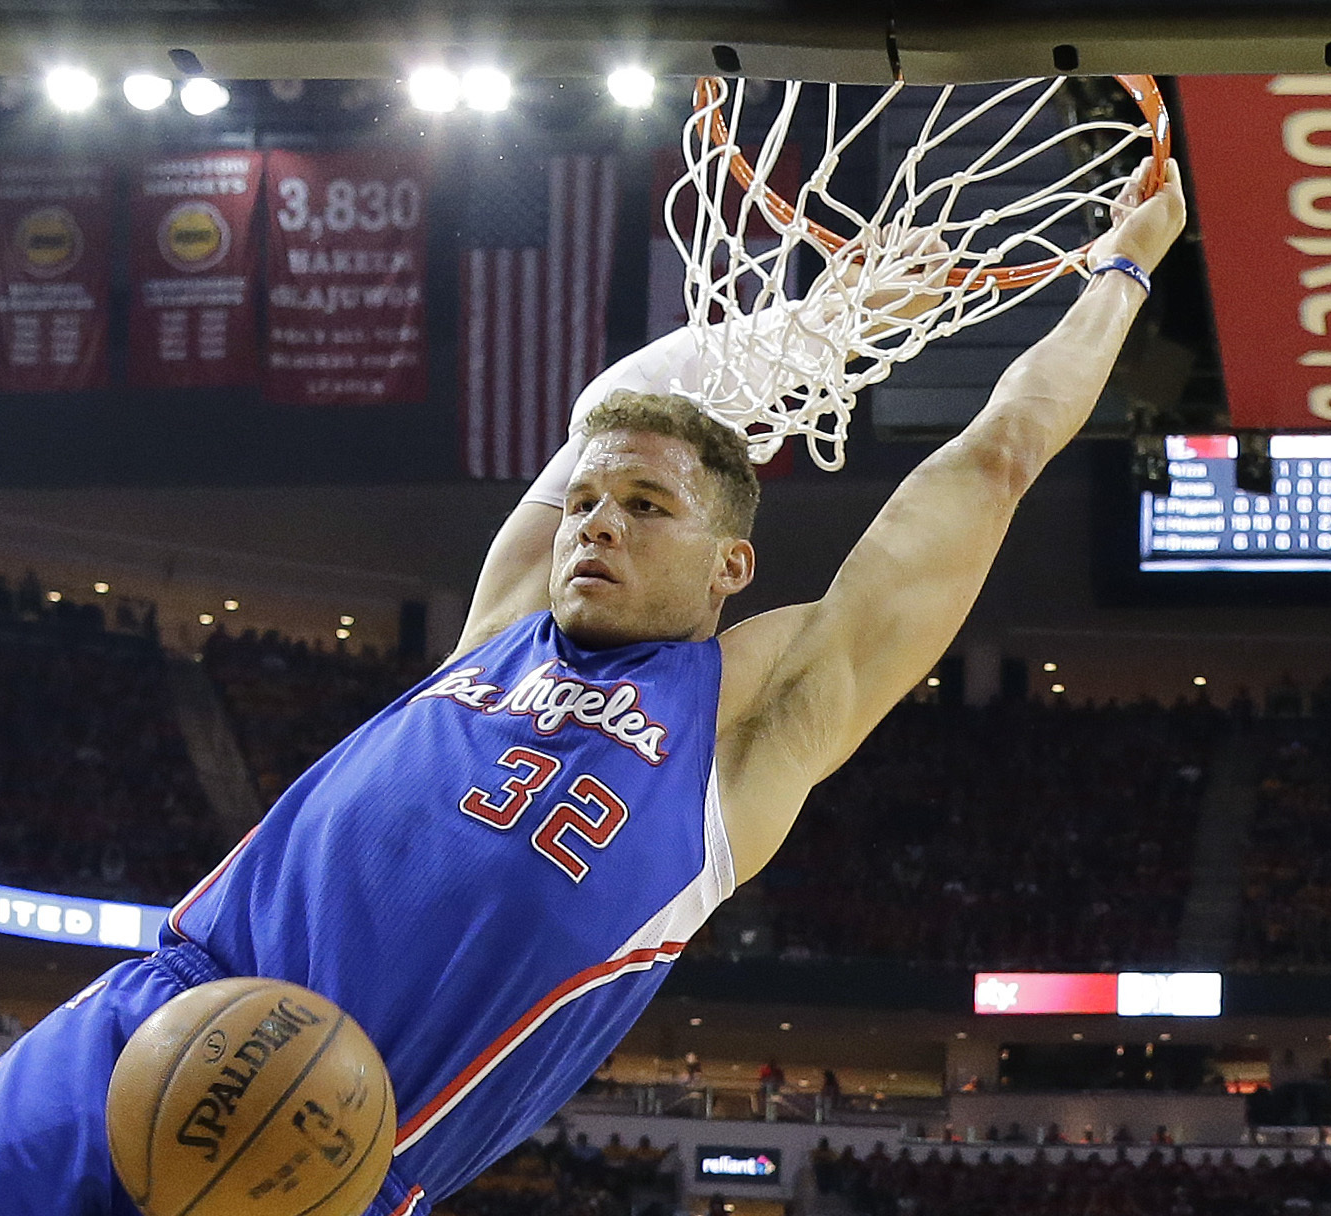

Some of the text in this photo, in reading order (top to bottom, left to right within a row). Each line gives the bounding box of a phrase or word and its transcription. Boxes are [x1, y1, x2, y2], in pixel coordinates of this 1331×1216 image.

[277, 176, 420, 241] 3,830
[406, 657, 670, 768] Los Angeles
[458, 745, 630, 885] 32
[176, 996, 325, 1164] SPALDING
[702, 1155, 758, 1176] reliant
